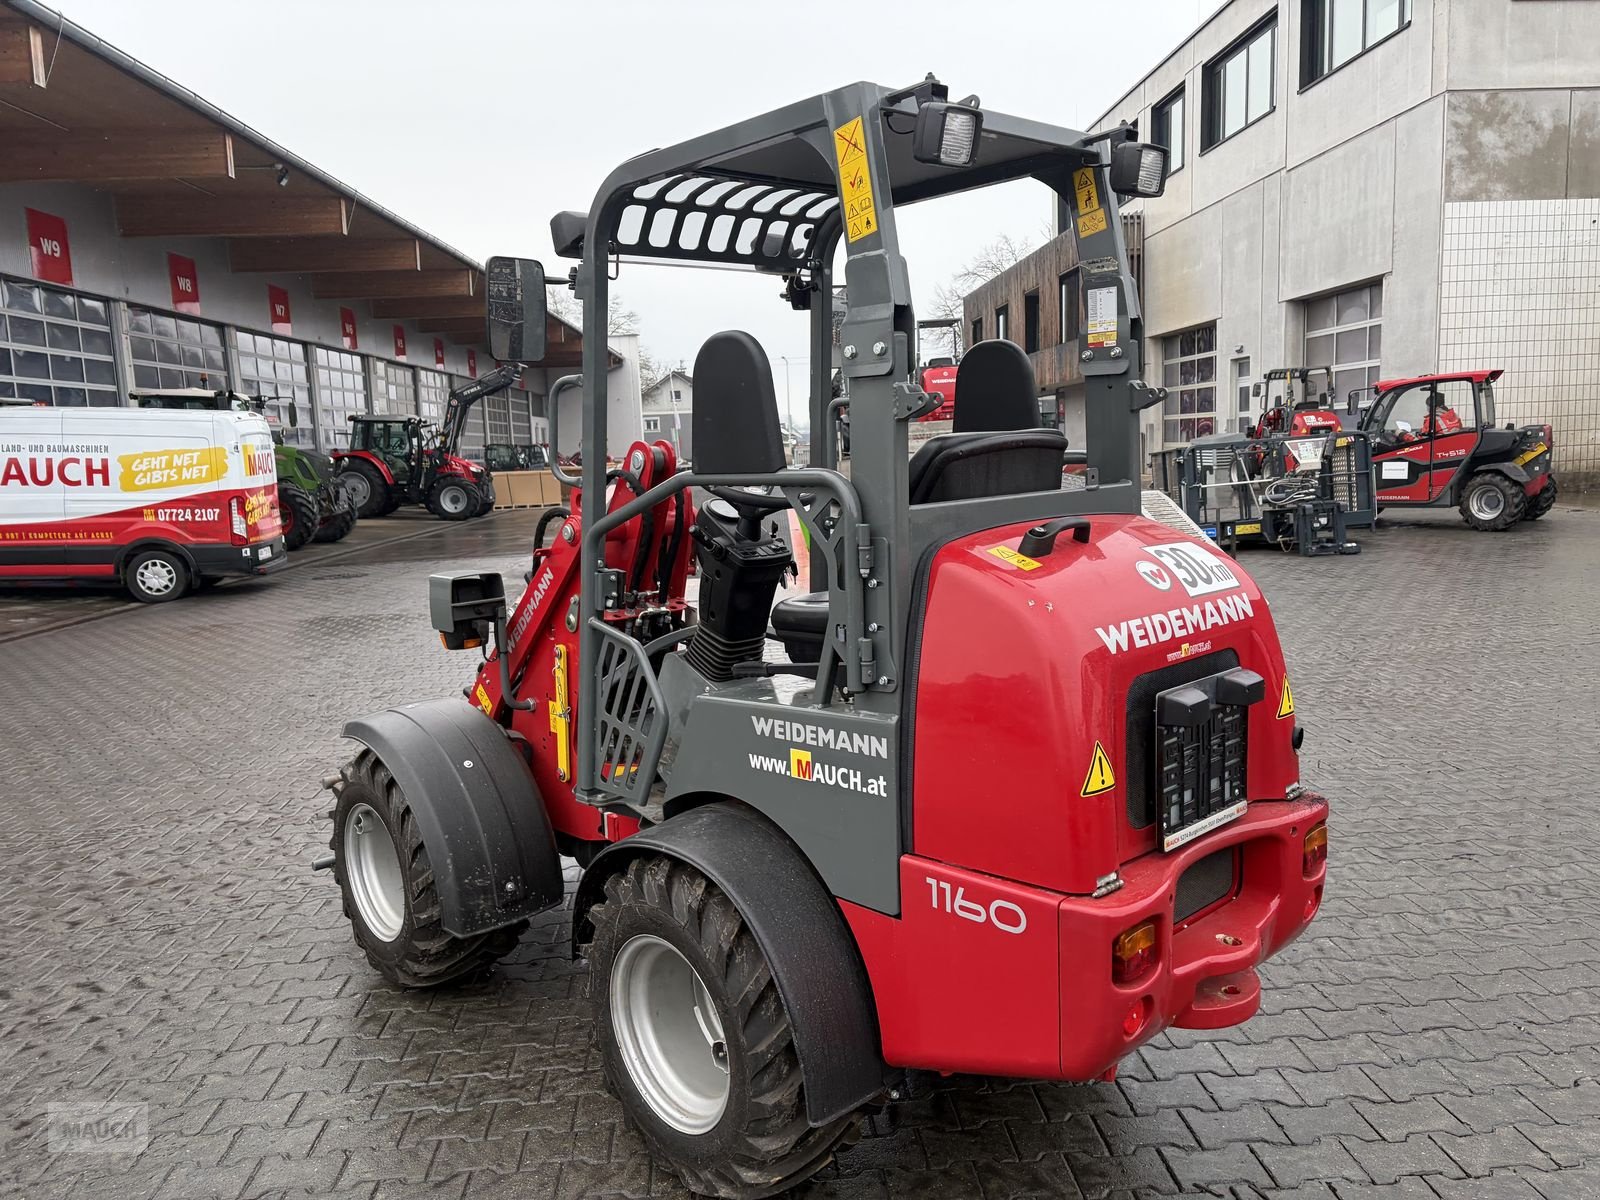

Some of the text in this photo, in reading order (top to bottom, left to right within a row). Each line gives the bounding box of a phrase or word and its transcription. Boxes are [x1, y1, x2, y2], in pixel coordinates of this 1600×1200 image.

[40, 237, 61, 258] W9
[177, 276, 192, 293] W8
[275, 304, 285, 317] W7
[1, 444, 109, 454] LAND- UND BAUMASCHINEN
[131, 452, 200, 472] GEHT NET
[134, 465, 209, 486] GIBTS NET
[157, 508, 220, 522] 07724 2107
[28, 532, 71, 540] KOMPETENZ
[91, 531, 113, 540] ACHSE
[1154, 547, 1234, 589] 30 km
[507, 567, 554, 653] WEIDEMANN
[1094, 593, 1254, 655] WEIDEMANN
[751, 715, 887, 759] WEIDEMANN
[748, 752, 887, 797] www.MAUCH.at
[926, 876, 1027, 934] 1160
